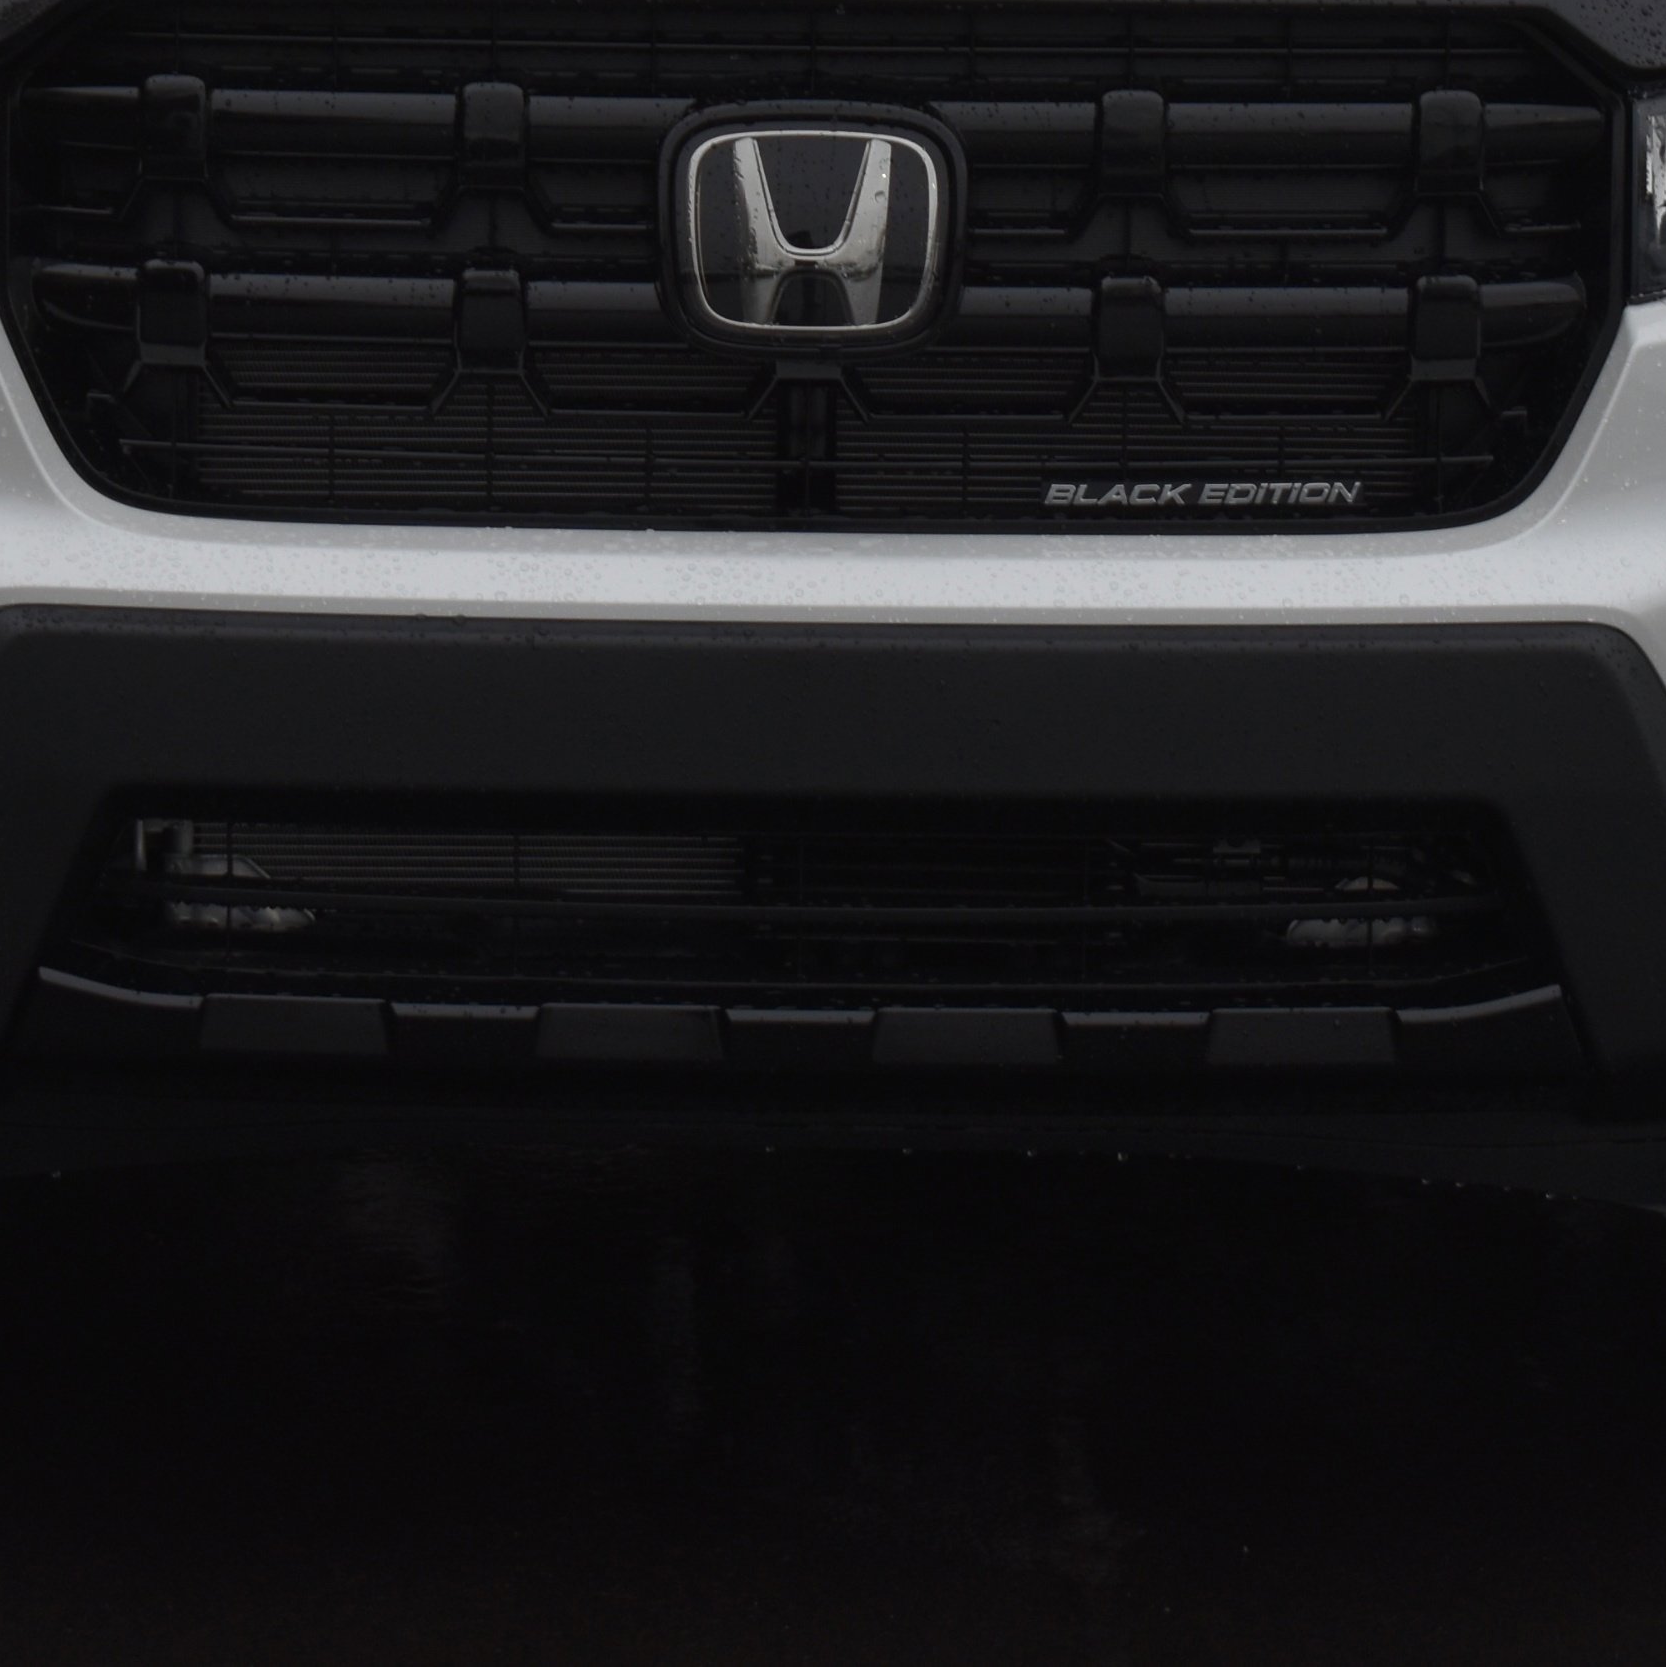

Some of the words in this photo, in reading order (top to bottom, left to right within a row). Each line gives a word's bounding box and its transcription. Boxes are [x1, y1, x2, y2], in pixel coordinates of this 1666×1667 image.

[733, 137, 892, 326] H
[1044, 483, 1192, 506] BLACK
[1199, 481, 1361, 505] EDITION
